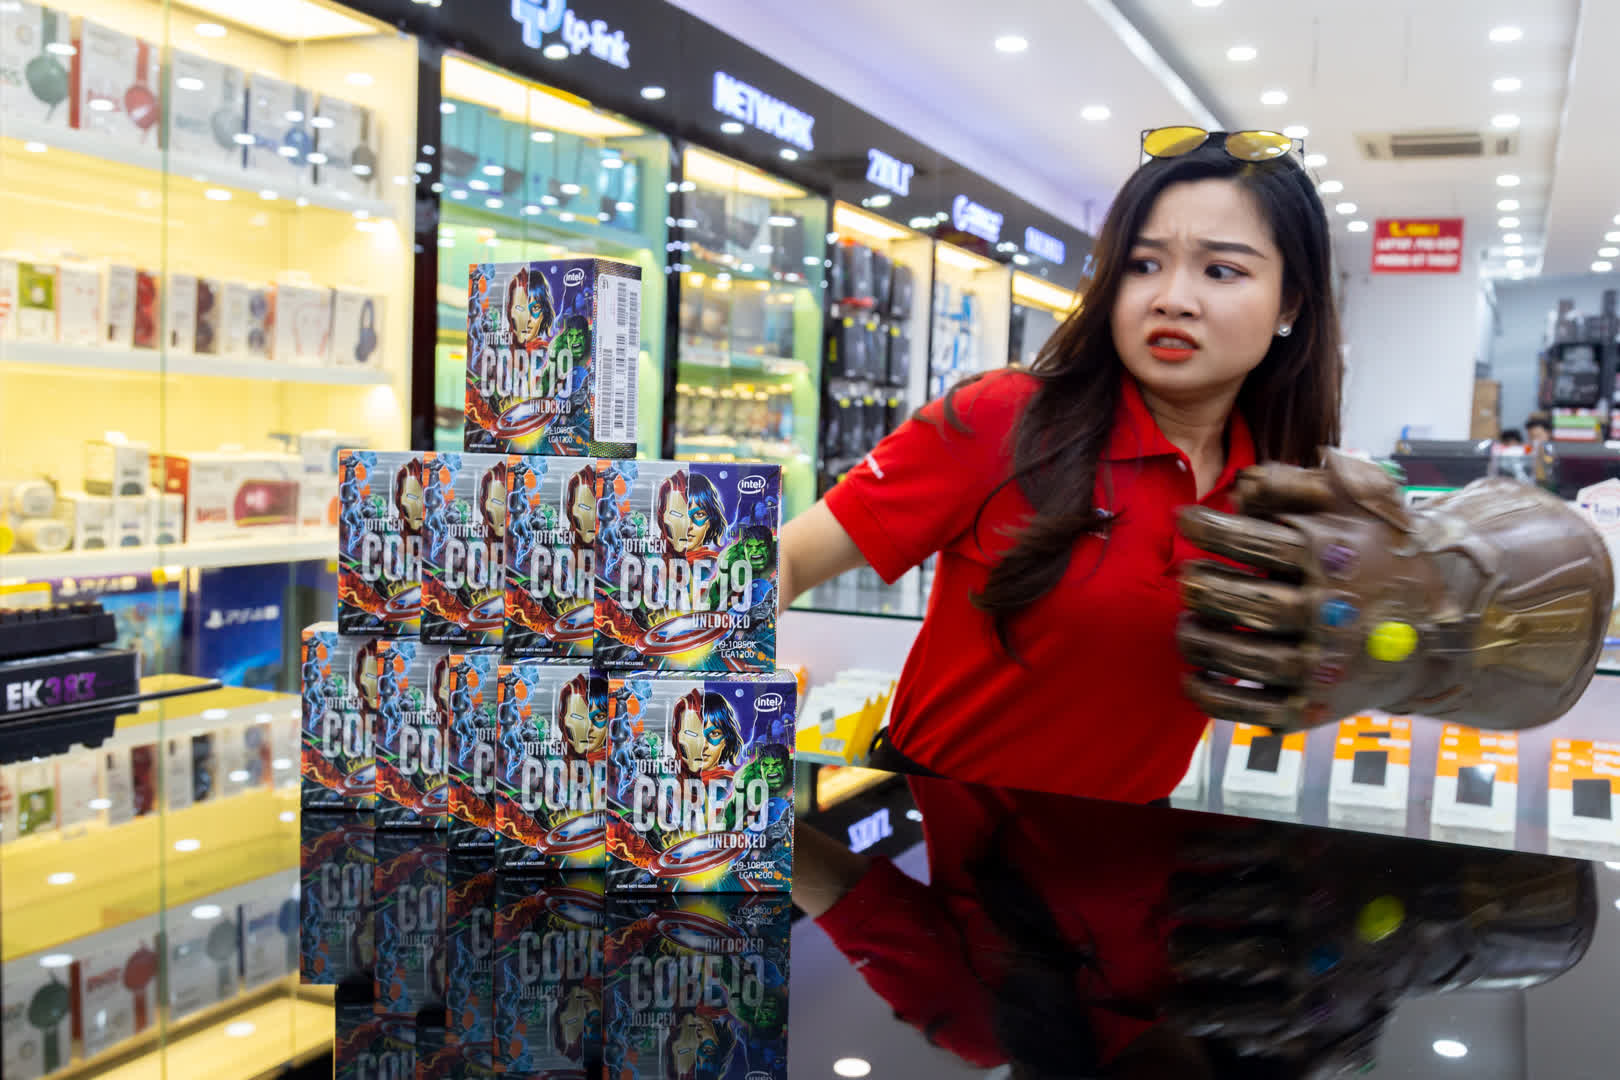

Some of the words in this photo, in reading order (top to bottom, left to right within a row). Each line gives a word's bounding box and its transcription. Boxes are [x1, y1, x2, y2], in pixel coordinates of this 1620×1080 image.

[712, 71, 815, 151] NETWORK
[480, 346, 544, 399] CORE
[547, 346, 574, 398] i9
[529, 400, 571, 414] UNLOCKED
[364, 518, 384, 532] 10TH
[387, 519, 404, 532] GEN
[448, 524, 469, 538] 10TH
[471, 524, 488, 538] GEN
[531, 529, 555, 544] 10TH
[557, 530, 575, 545] GEN
[623, 538, 646, 553] 10TH
[649, 539, 667, 553] GEN
[361, 533, 422, 583] COR
[444, 540, 503, 590] COR
[530, 546, 595, 599] COR
[620, 556, 712, 611] CORE
[718, 558, 753, 612] i9
[693, 613, 750, 629] UNLOCKED
[721, 650, 755, 658] LGA1200
[325, 697, 344, 710] 10TH
[345, 698, 363, 710] GEN
[757, 696, 778, 706] intel
[401, 711, 422, 725] 10TH
[424, 711, 441, 725] GEN
[524, 741, 546, 756] 10TH
[549, 742, 568, 756] GEN
[635, 759, 658, 774] 10TH
[662, 759, 681, 774] GEN
[521, 756, 606, 812] CORE
[633, 774, 728, 833] CORE
[734, 777, 769, 832] i9
[707, 834, 766, 848] UNLOCKED
